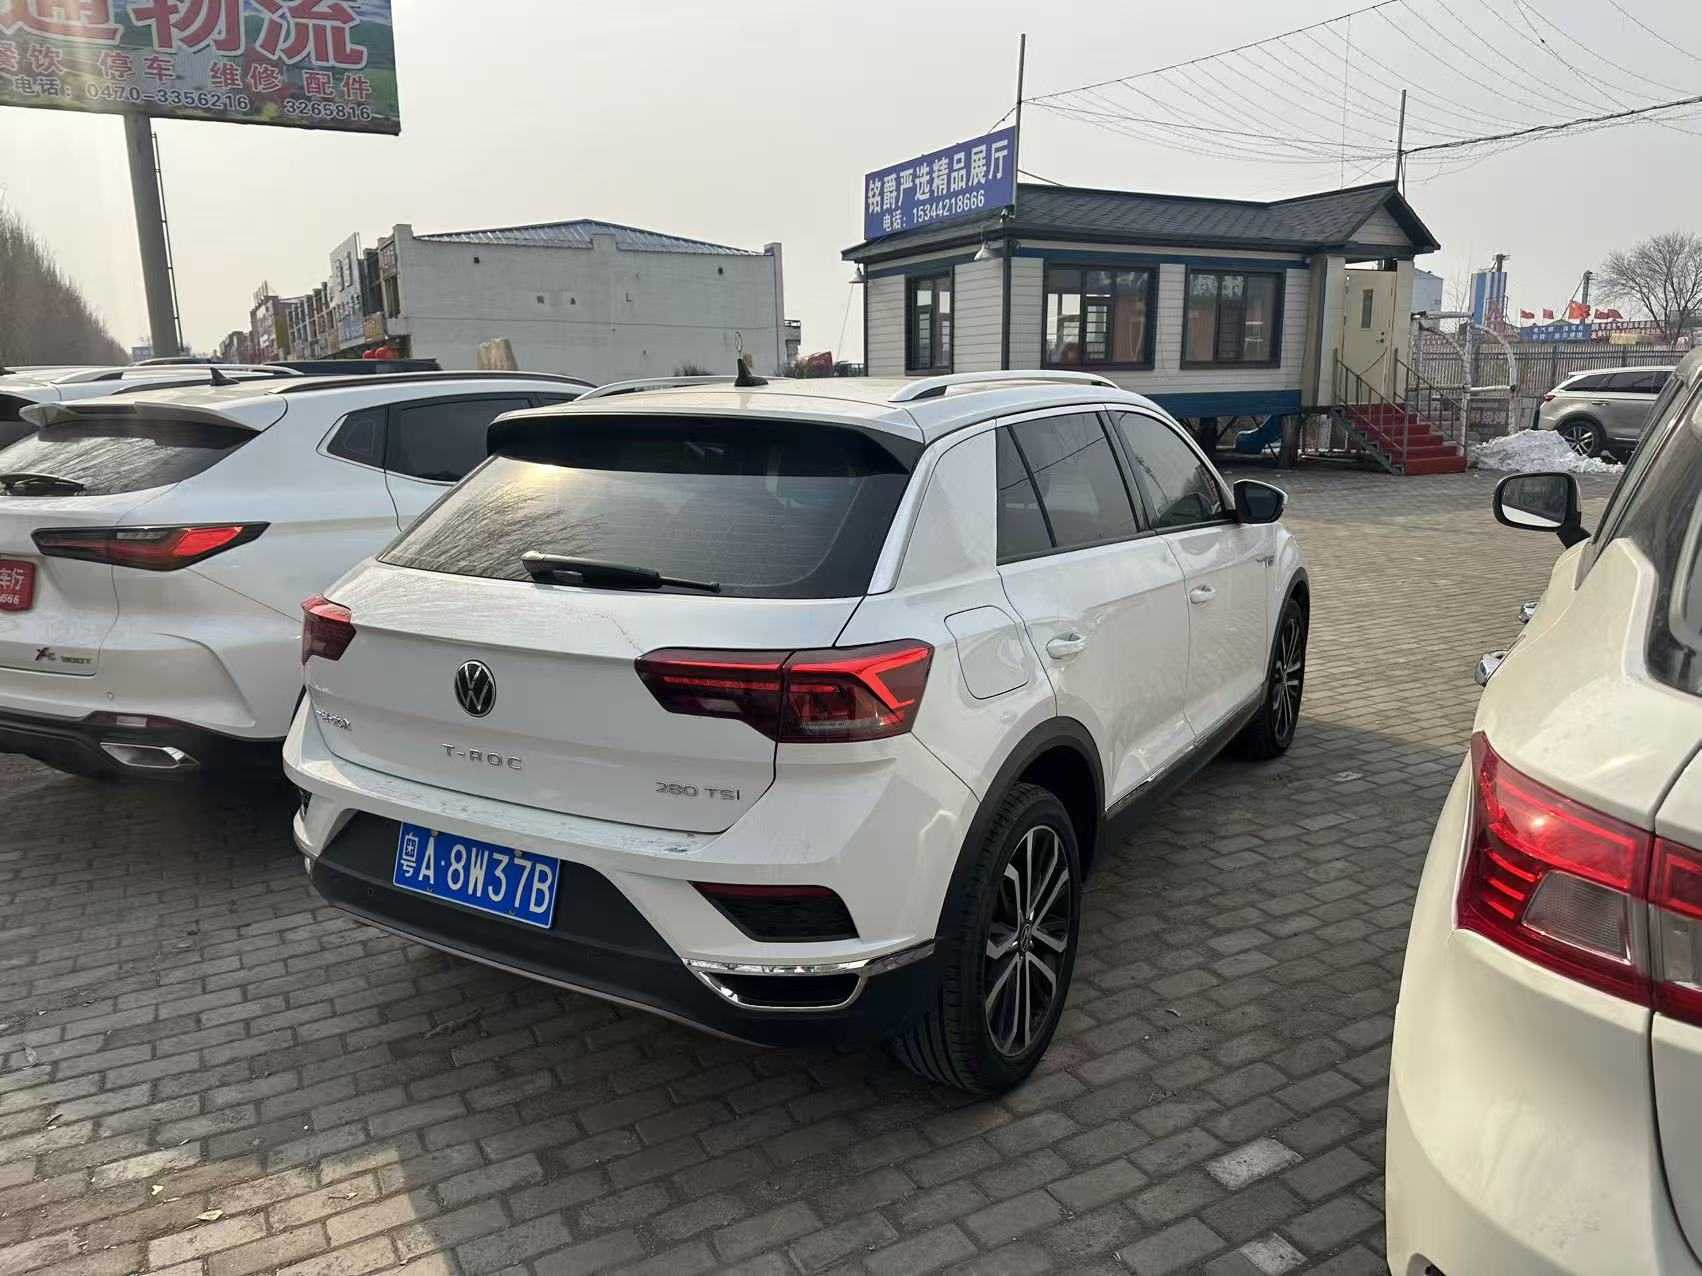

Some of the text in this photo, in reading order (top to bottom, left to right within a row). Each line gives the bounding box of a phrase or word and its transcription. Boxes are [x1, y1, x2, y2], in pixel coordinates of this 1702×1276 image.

[98, 49, 175, 81] 停车
[209, 61, 281, 92] 维修
[303, 70, 372, 101] 配件
[85, 82, 250, 111] 0470-3356216
[286, 100, 371, 120] 3265816
[867, 139, 1009, 215] 铭爵严选精品展厅
[912, 190, 985, 223] 15344218666
[441, 743, 523, 771] T-ROC
[655, 781, 698, 798] 280
